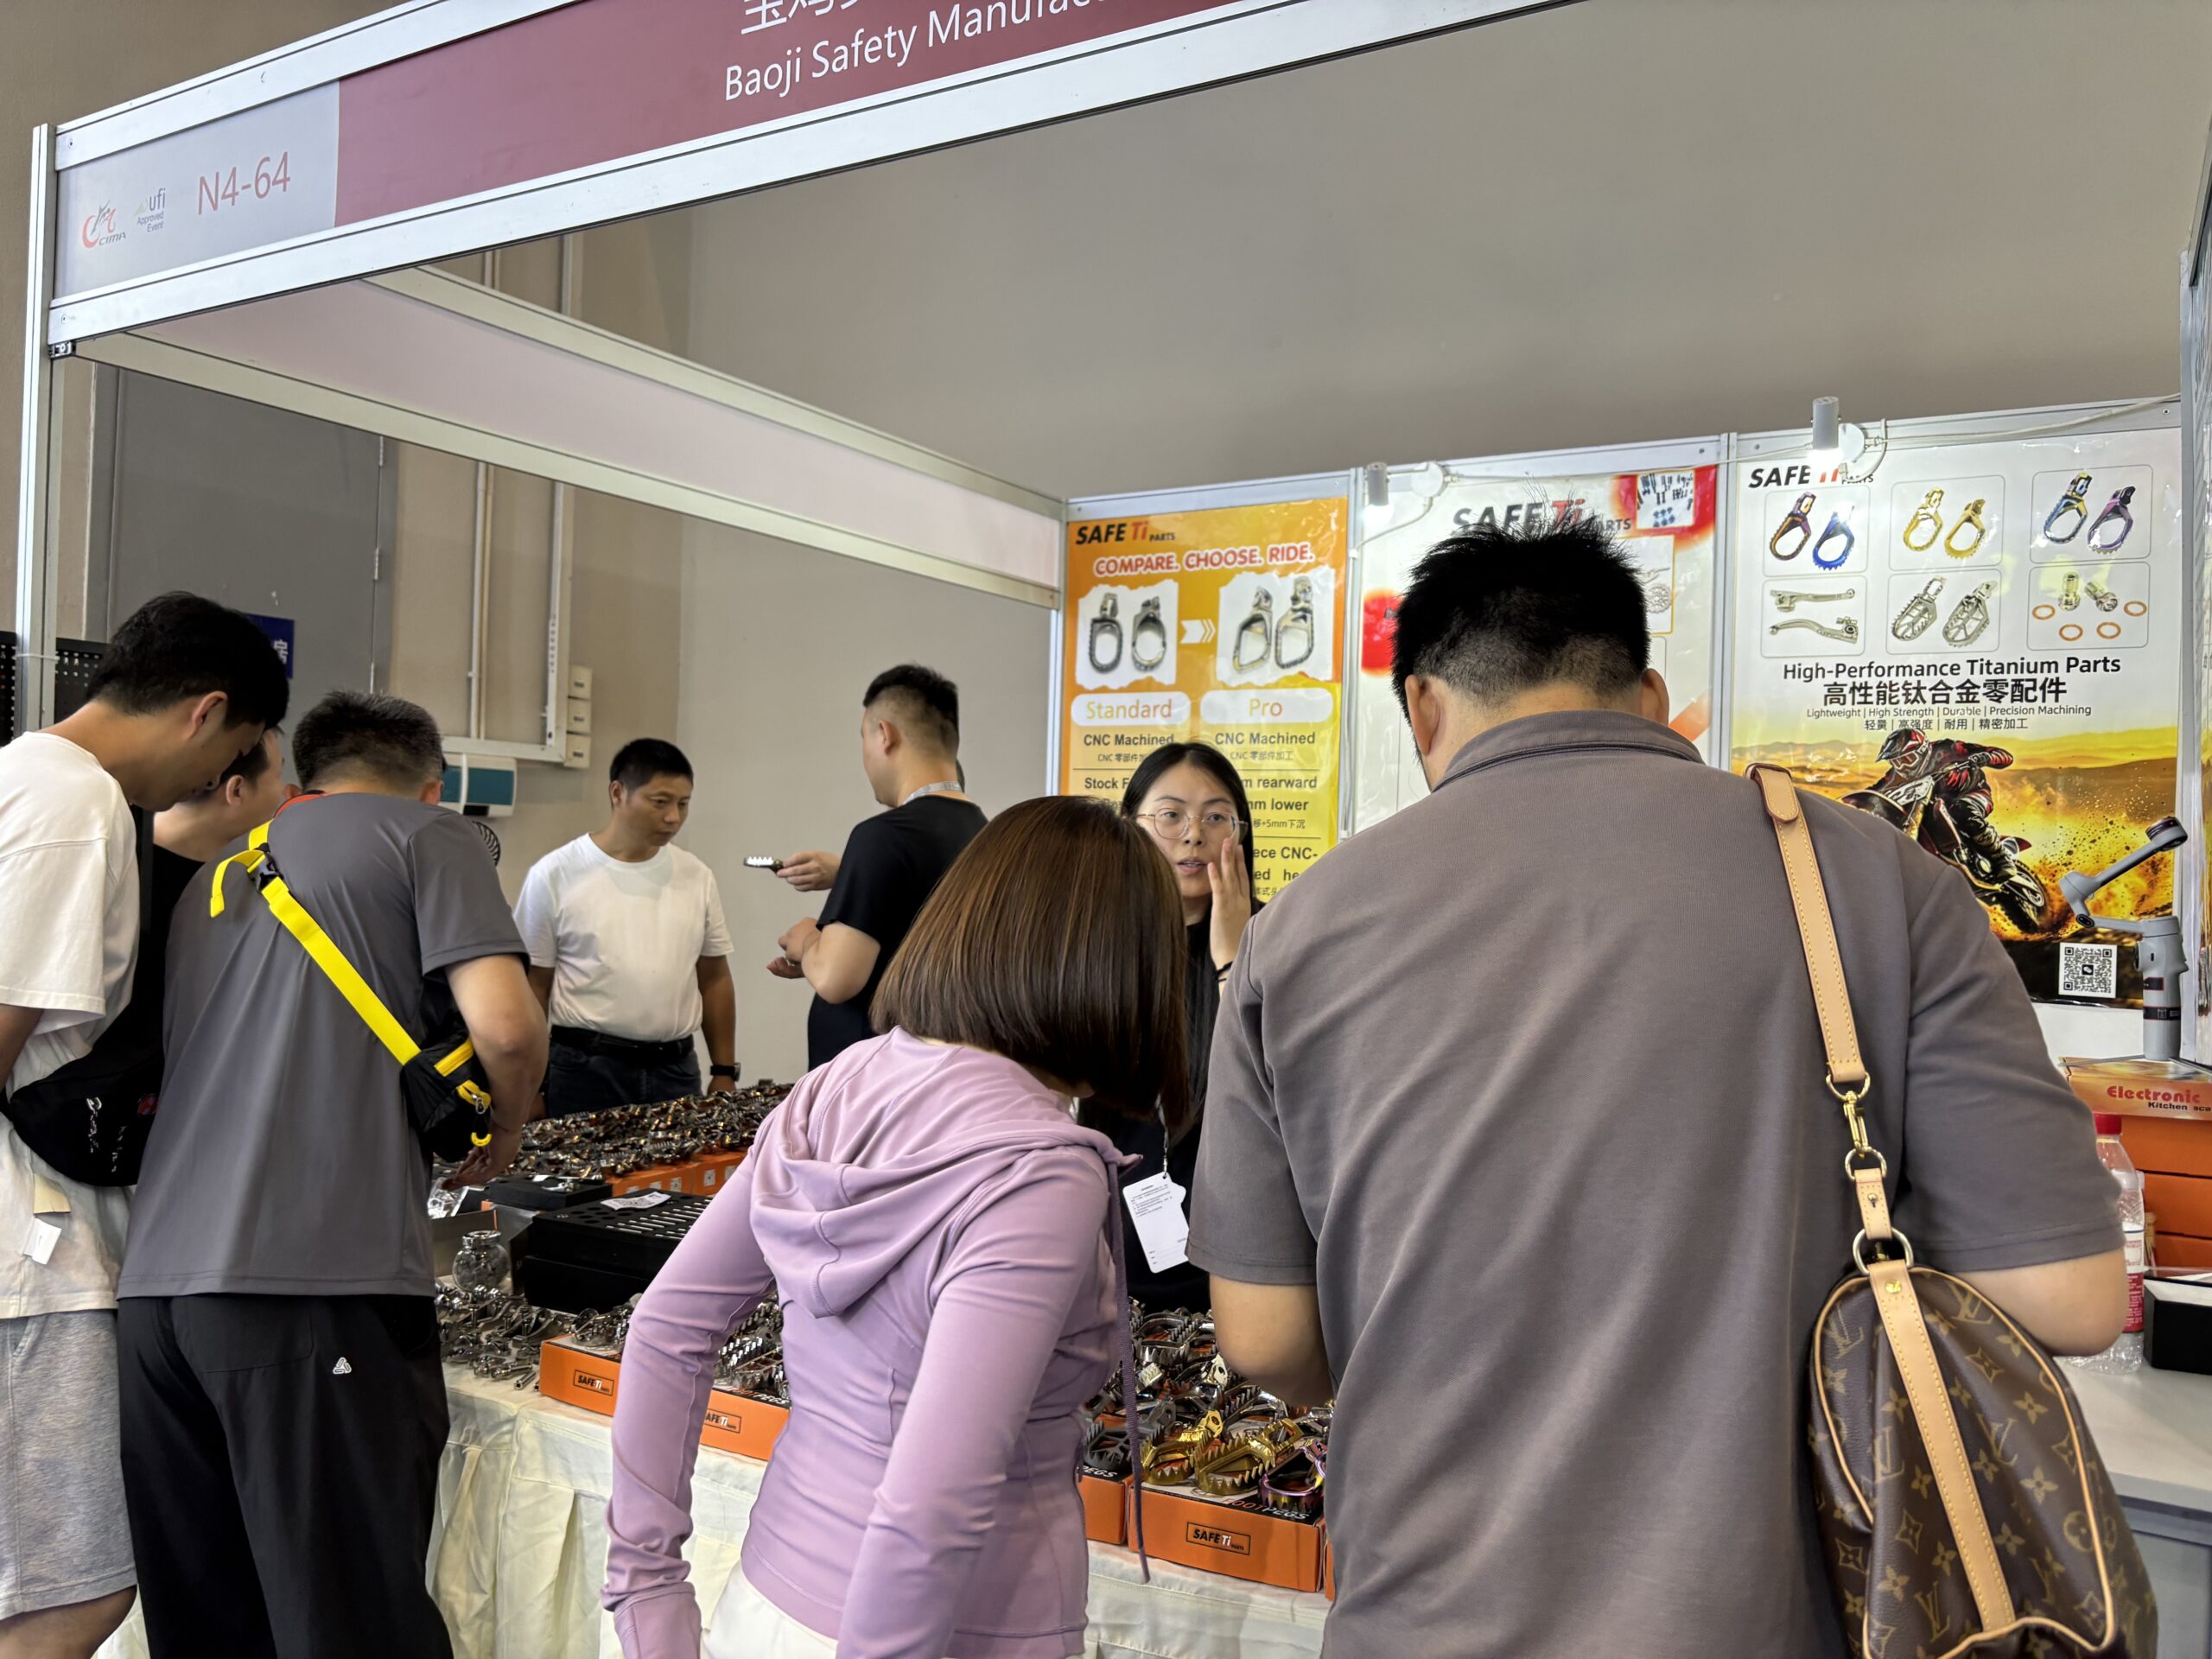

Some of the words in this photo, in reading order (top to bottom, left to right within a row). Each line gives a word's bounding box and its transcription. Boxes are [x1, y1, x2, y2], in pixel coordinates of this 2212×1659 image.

[725, 47, 801, 101] Baoji
[811, 25, 918, 78] Safety
[198, 151, 291, 215] N4-64
[149, 188, 166, 212] ufi
[137, 210, 164, 226] Approved
[147, 220, 164, 232] Event
[1748, 465, 1811, 488] SAFE
[1076, 523, 1127, 545] SAFE
[1132, 520, 1149, 541] Ti
[1094, 554, 1179, 576] COMPARE.
[1185, 547, 1262, 569] CHOOSE.
[1268, 543, 1313, 563] RIDE.
[1783, 661, 1961, 683] High-Performance
[1967, 657, 2059, 676] Titanium
[2066, 656, 2121, 674] Parts
[1823, 677, 2068, 707] 高性能钛合金零配件
[1086, 698, 1173, 719] Standard
[1249, 697, 1283, 717] Pro
[1807, 708, 1861, 720] Lightweight
[1868, 708, 1891, 719] High
[1893, 707, 1935, 719] Strength
[1942, 706, 1981, 716] Durable
[1989, 705, 2035, 716] Precision
[2037, 705, 2092, 716] Machining
[1865, 719, 1887, 731] 轻量
[1944, 718, 1967, 731] 耐用
[1978, 717, 2029, 730] 精密加工
[1084, 734, 1111, 746] CNC
[1115, 733, 1174, 746] Machined
[1215, 732, 1244, 745] CNC
[1249, 731, 1316, 745] Machined
[1230, 751, 1249, 760] CNC
[1084, 777, 1118, 789] Stock
[1257, 776, 1318, 789] rearward
[1270, 798, 1309, 810] lower
[1281, 846, 1319, 860] CNC-
[2107, 1085, 2201, 1103] Electronic
[2147, 1101, 2189, 1110] Kitchen
[704, 1413, 720, 1424] AFE
[1193, 1529, 1220, 1544] SAFE
[1222, 1535, 1232, 1547] Ti
